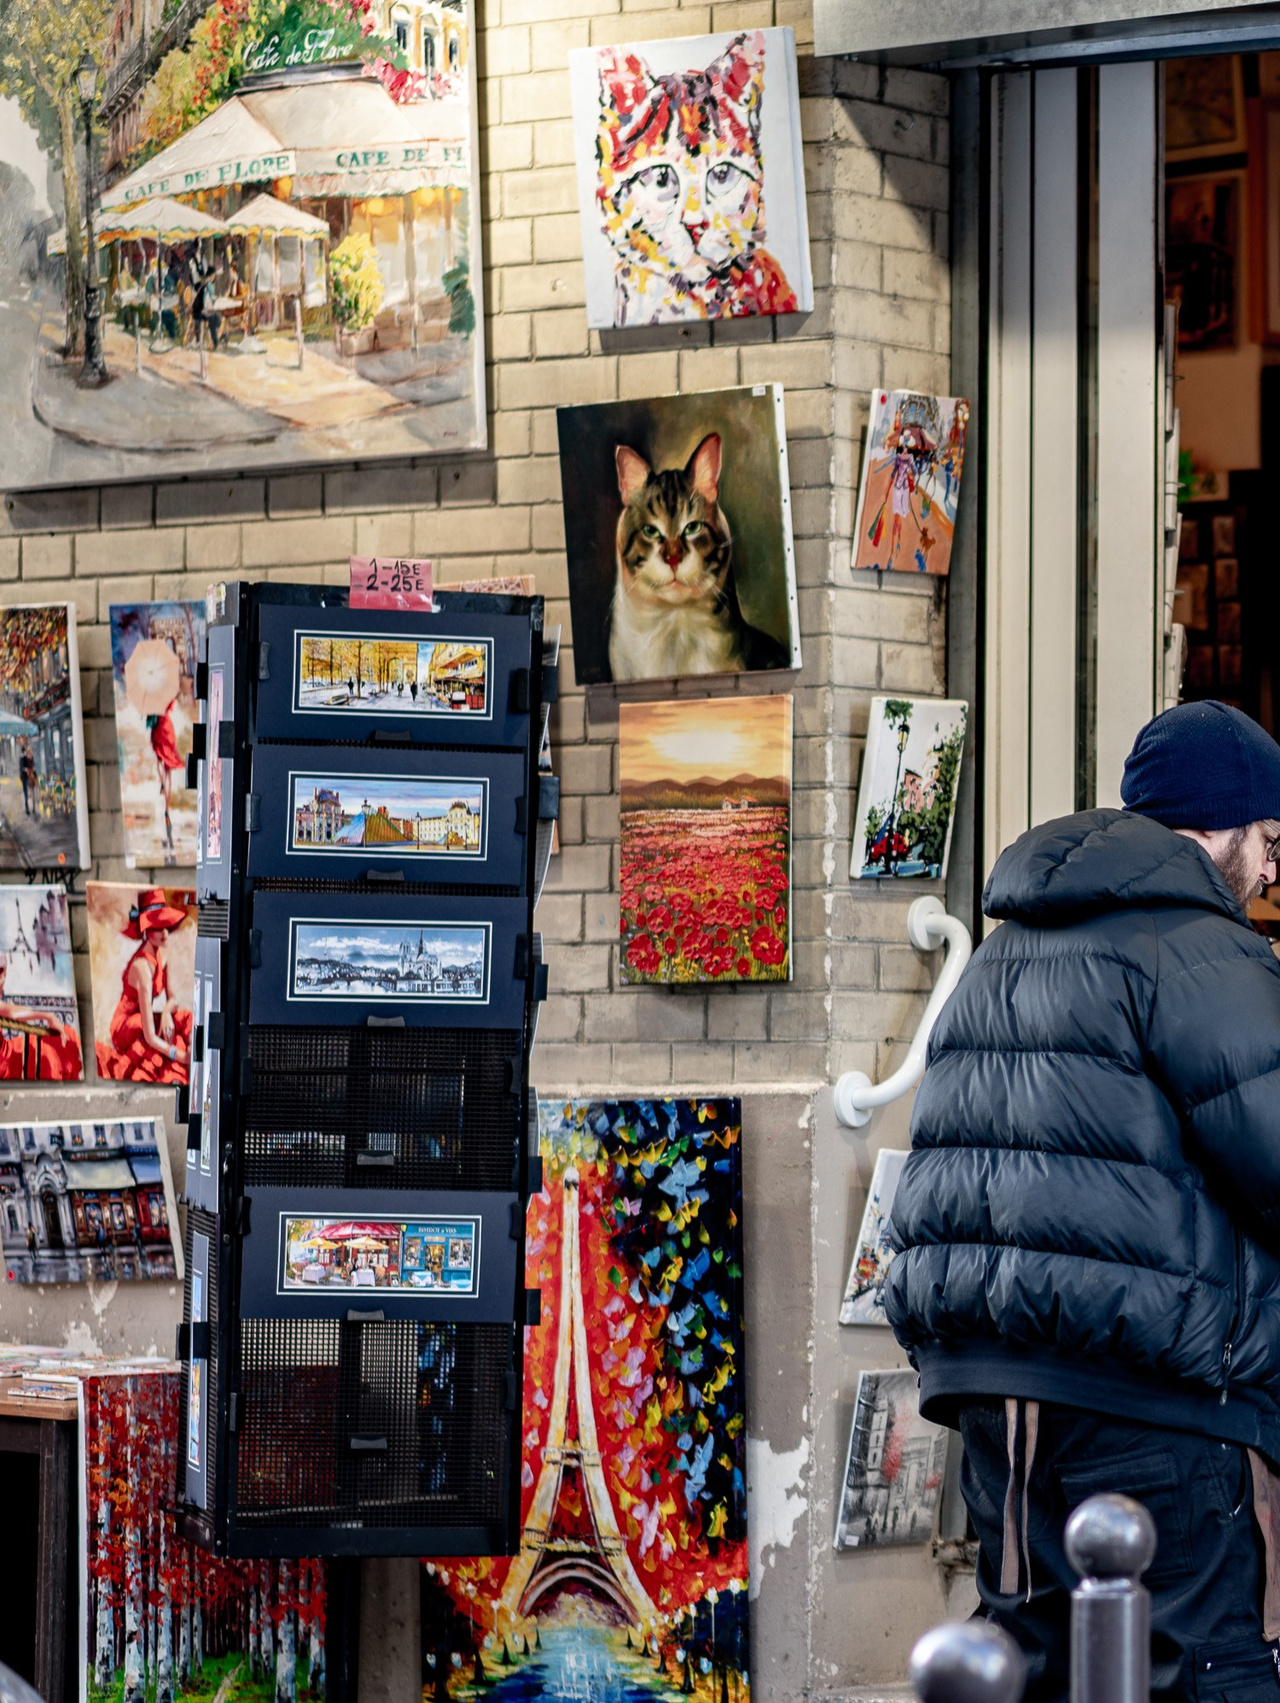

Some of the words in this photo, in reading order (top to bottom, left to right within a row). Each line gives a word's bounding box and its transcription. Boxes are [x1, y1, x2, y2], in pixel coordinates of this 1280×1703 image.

[336, 150, 390, 168] CAFE
[402, 147, 428, 163] DE
[124, 179, 170, 201] CAFE
[184, 169, 209, 188] DE
[218, 155, 291, 183] FLORE
